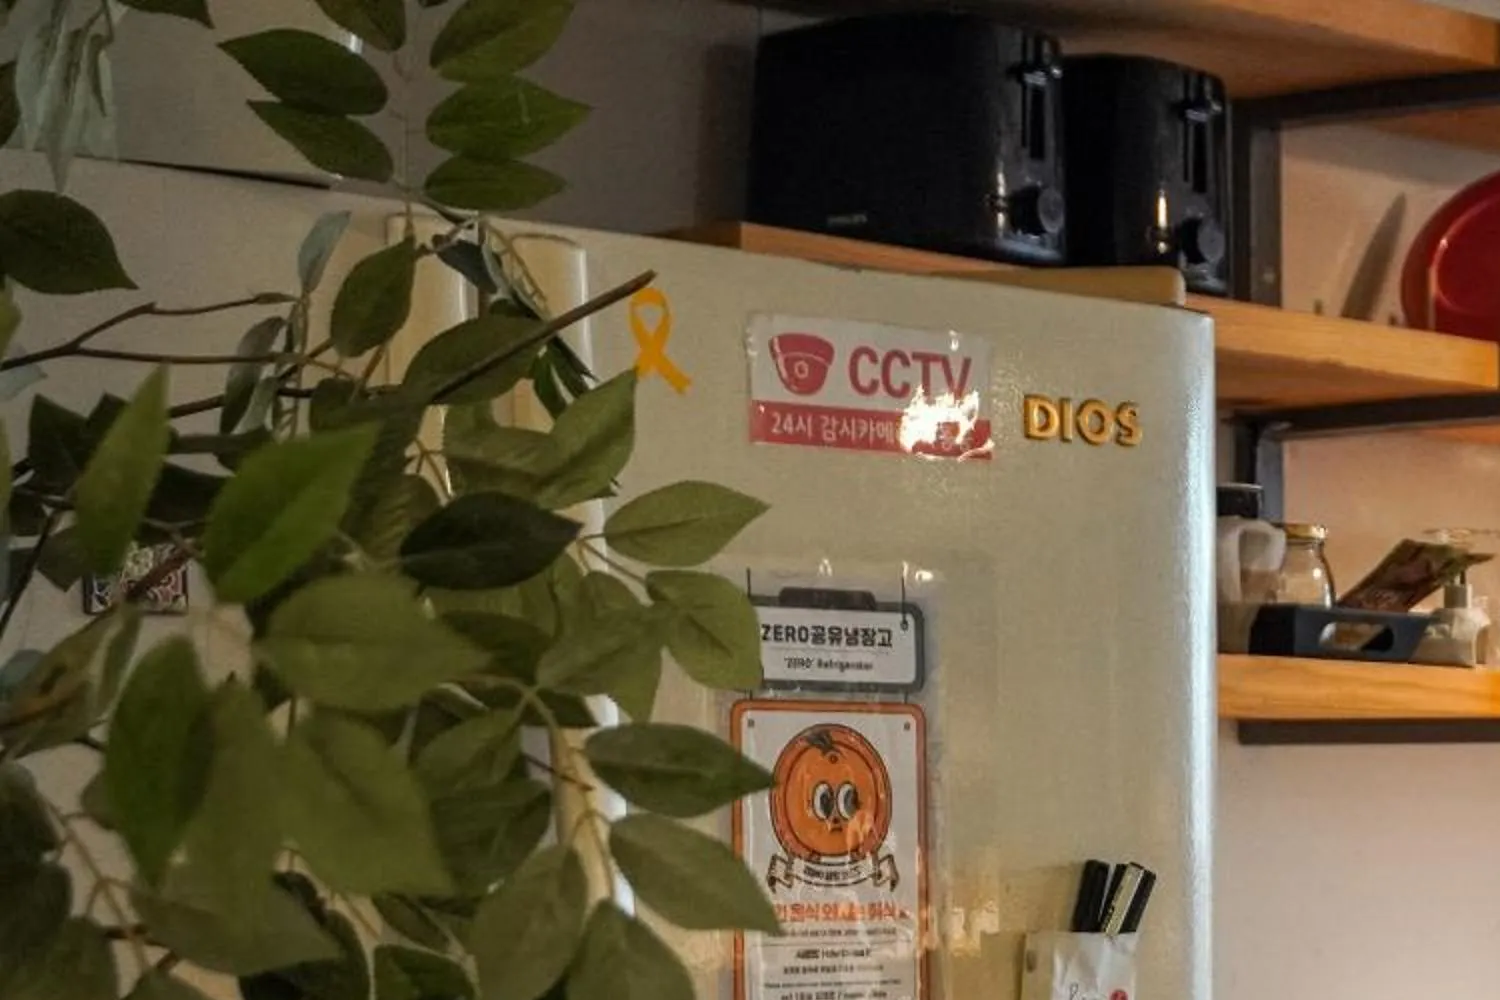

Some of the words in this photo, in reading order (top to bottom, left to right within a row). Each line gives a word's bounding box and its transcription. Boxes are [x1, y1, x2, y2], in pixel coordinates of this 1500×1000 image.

[848, 345, 973, 400] CCTV
[770, 411, 813, 438] 24시
[821, 414, 908, 446] 감시카메
[1023, 393, 1142, 447] DIOS
[761, 623, 893, 648] ZERO공유냉장고
